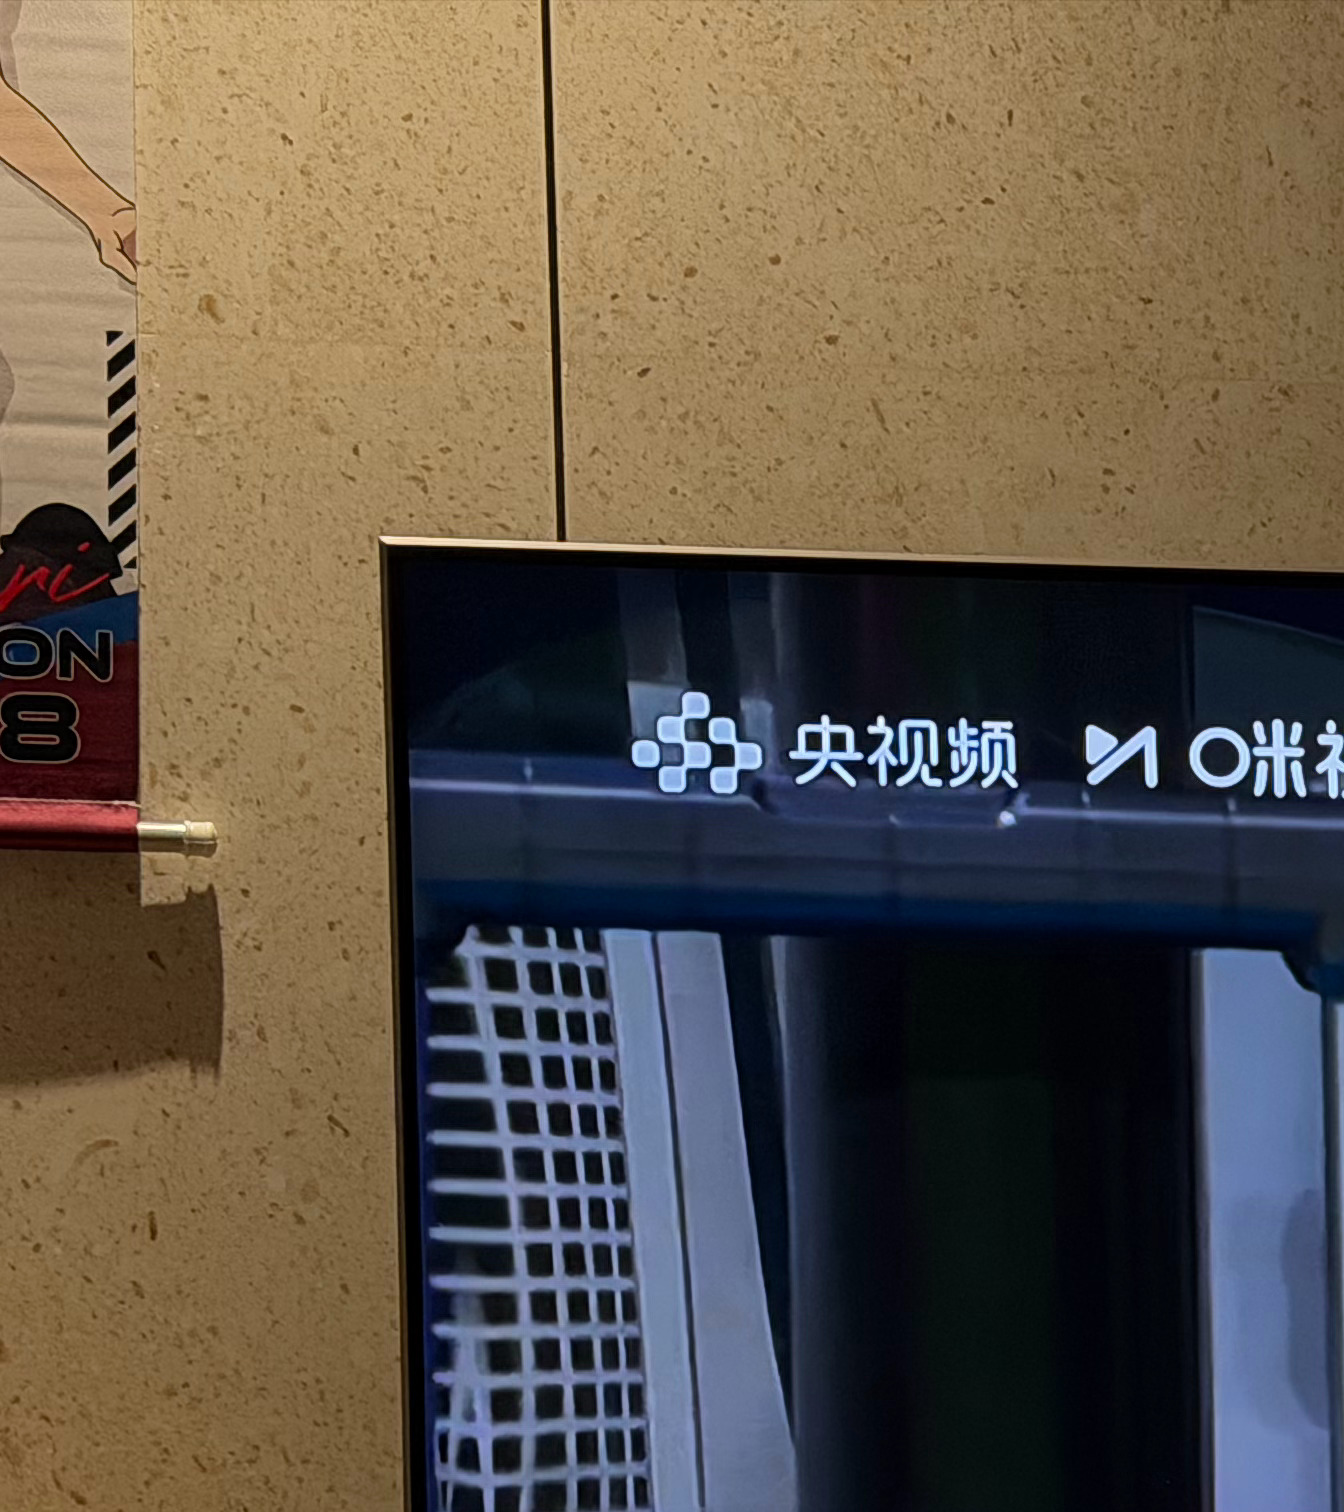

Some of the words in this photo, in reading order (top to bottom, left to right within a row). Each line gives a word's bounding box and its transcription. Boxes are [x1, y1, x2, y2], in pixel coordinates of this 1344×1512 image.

[0, 624, 113, 682] ON
[0, 691, 81, 764] 8
[788, 714, 1019, 789] 央视频
